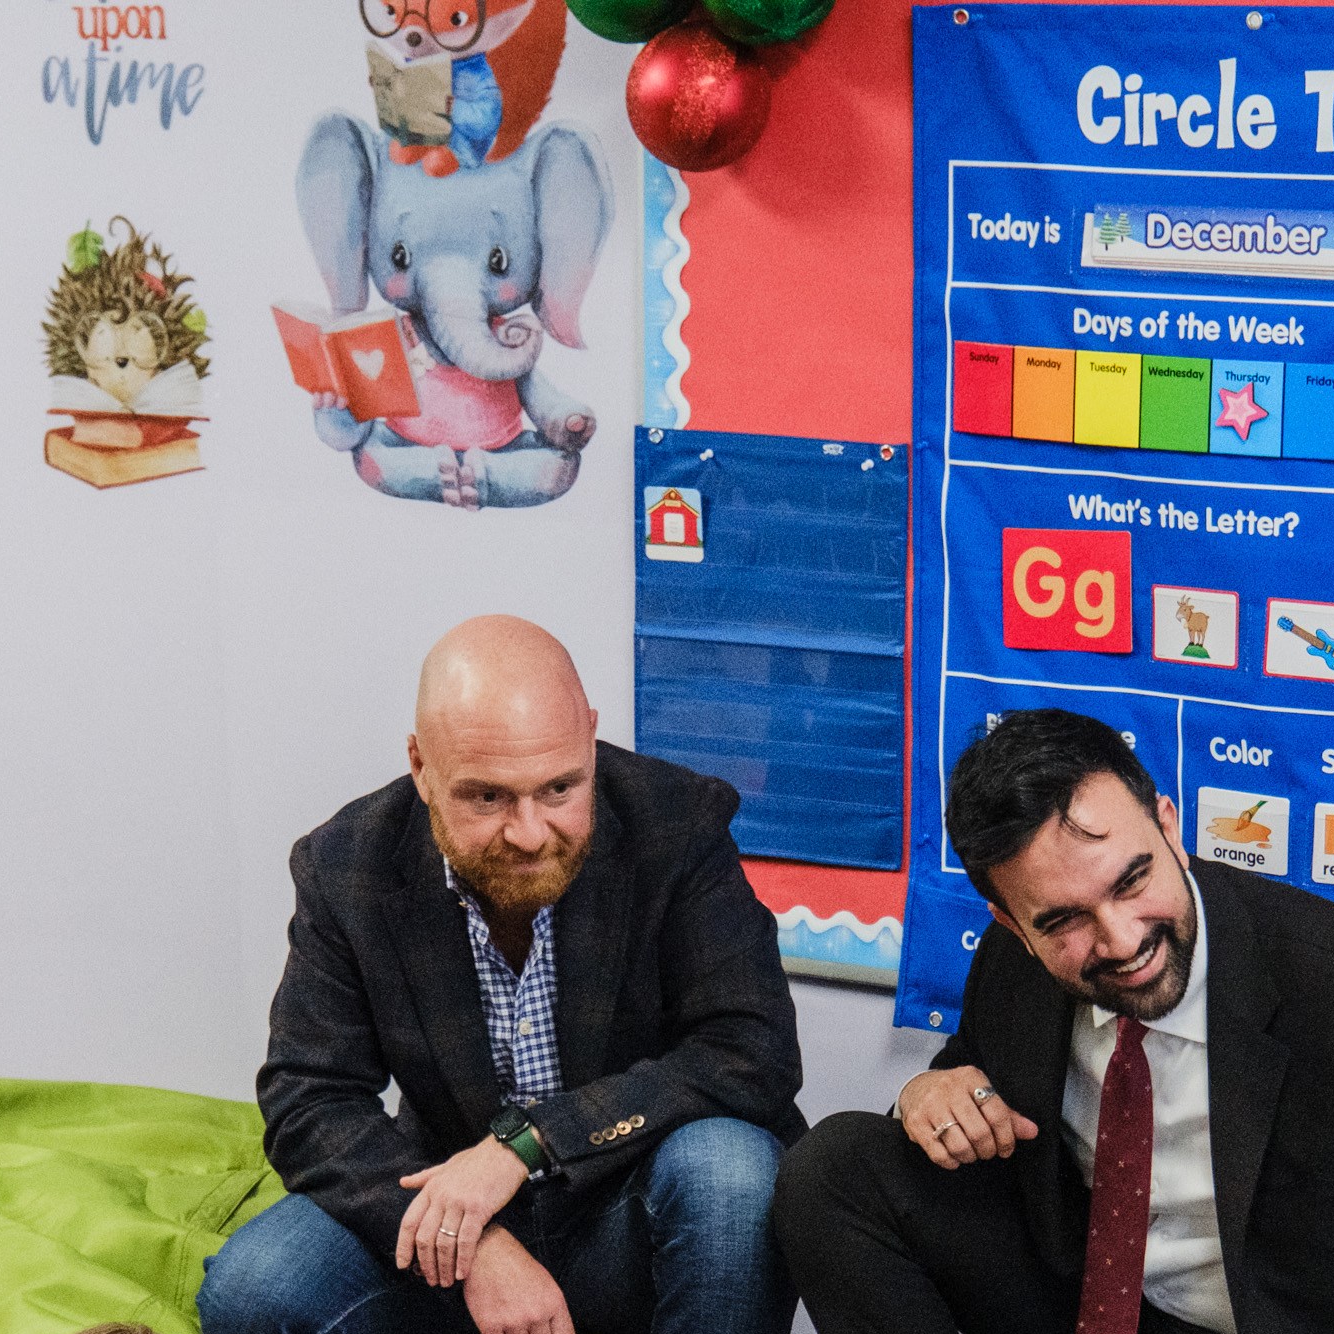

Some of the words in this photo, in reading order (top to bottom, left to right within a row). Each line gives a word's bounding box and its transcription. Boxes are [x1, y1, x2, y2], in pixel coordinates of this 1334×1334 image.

[71, 5, 168, 52] upon
[41, 55, 79, 108] a
[84, 41, 205, 146] time
[1076, 57, 1278, 151] Circle
[968, 213, 1040, 248] Today
[1044, 215, 1061, 244] is
[1145, 213, 1327, 256] December
[1073, 307, 1134, 340] Days
[1140, 310, 1170, 339] of
[1176, 311, 1221, 342] the
[1228, 316, 1305, 347] Week
[968, 352, 1001, 367] Sunday
[1026, 357, 1062, 372] Monday
[1089, 361, 1128, 377] Tuesday
[1148, 366, 1205, 382] Wednesday
[1224, 370, 1271, 386] Thursday
[1068, 494, 1152, 525] What's
[1157, 502, 1200, 531] the
[1205, 506, 1301, 539] Letter?
[1012, 547, 1117, 639] Gg
[1209, 737, 1273, 768] Color
[1213, 846, 1267, 868] orange
